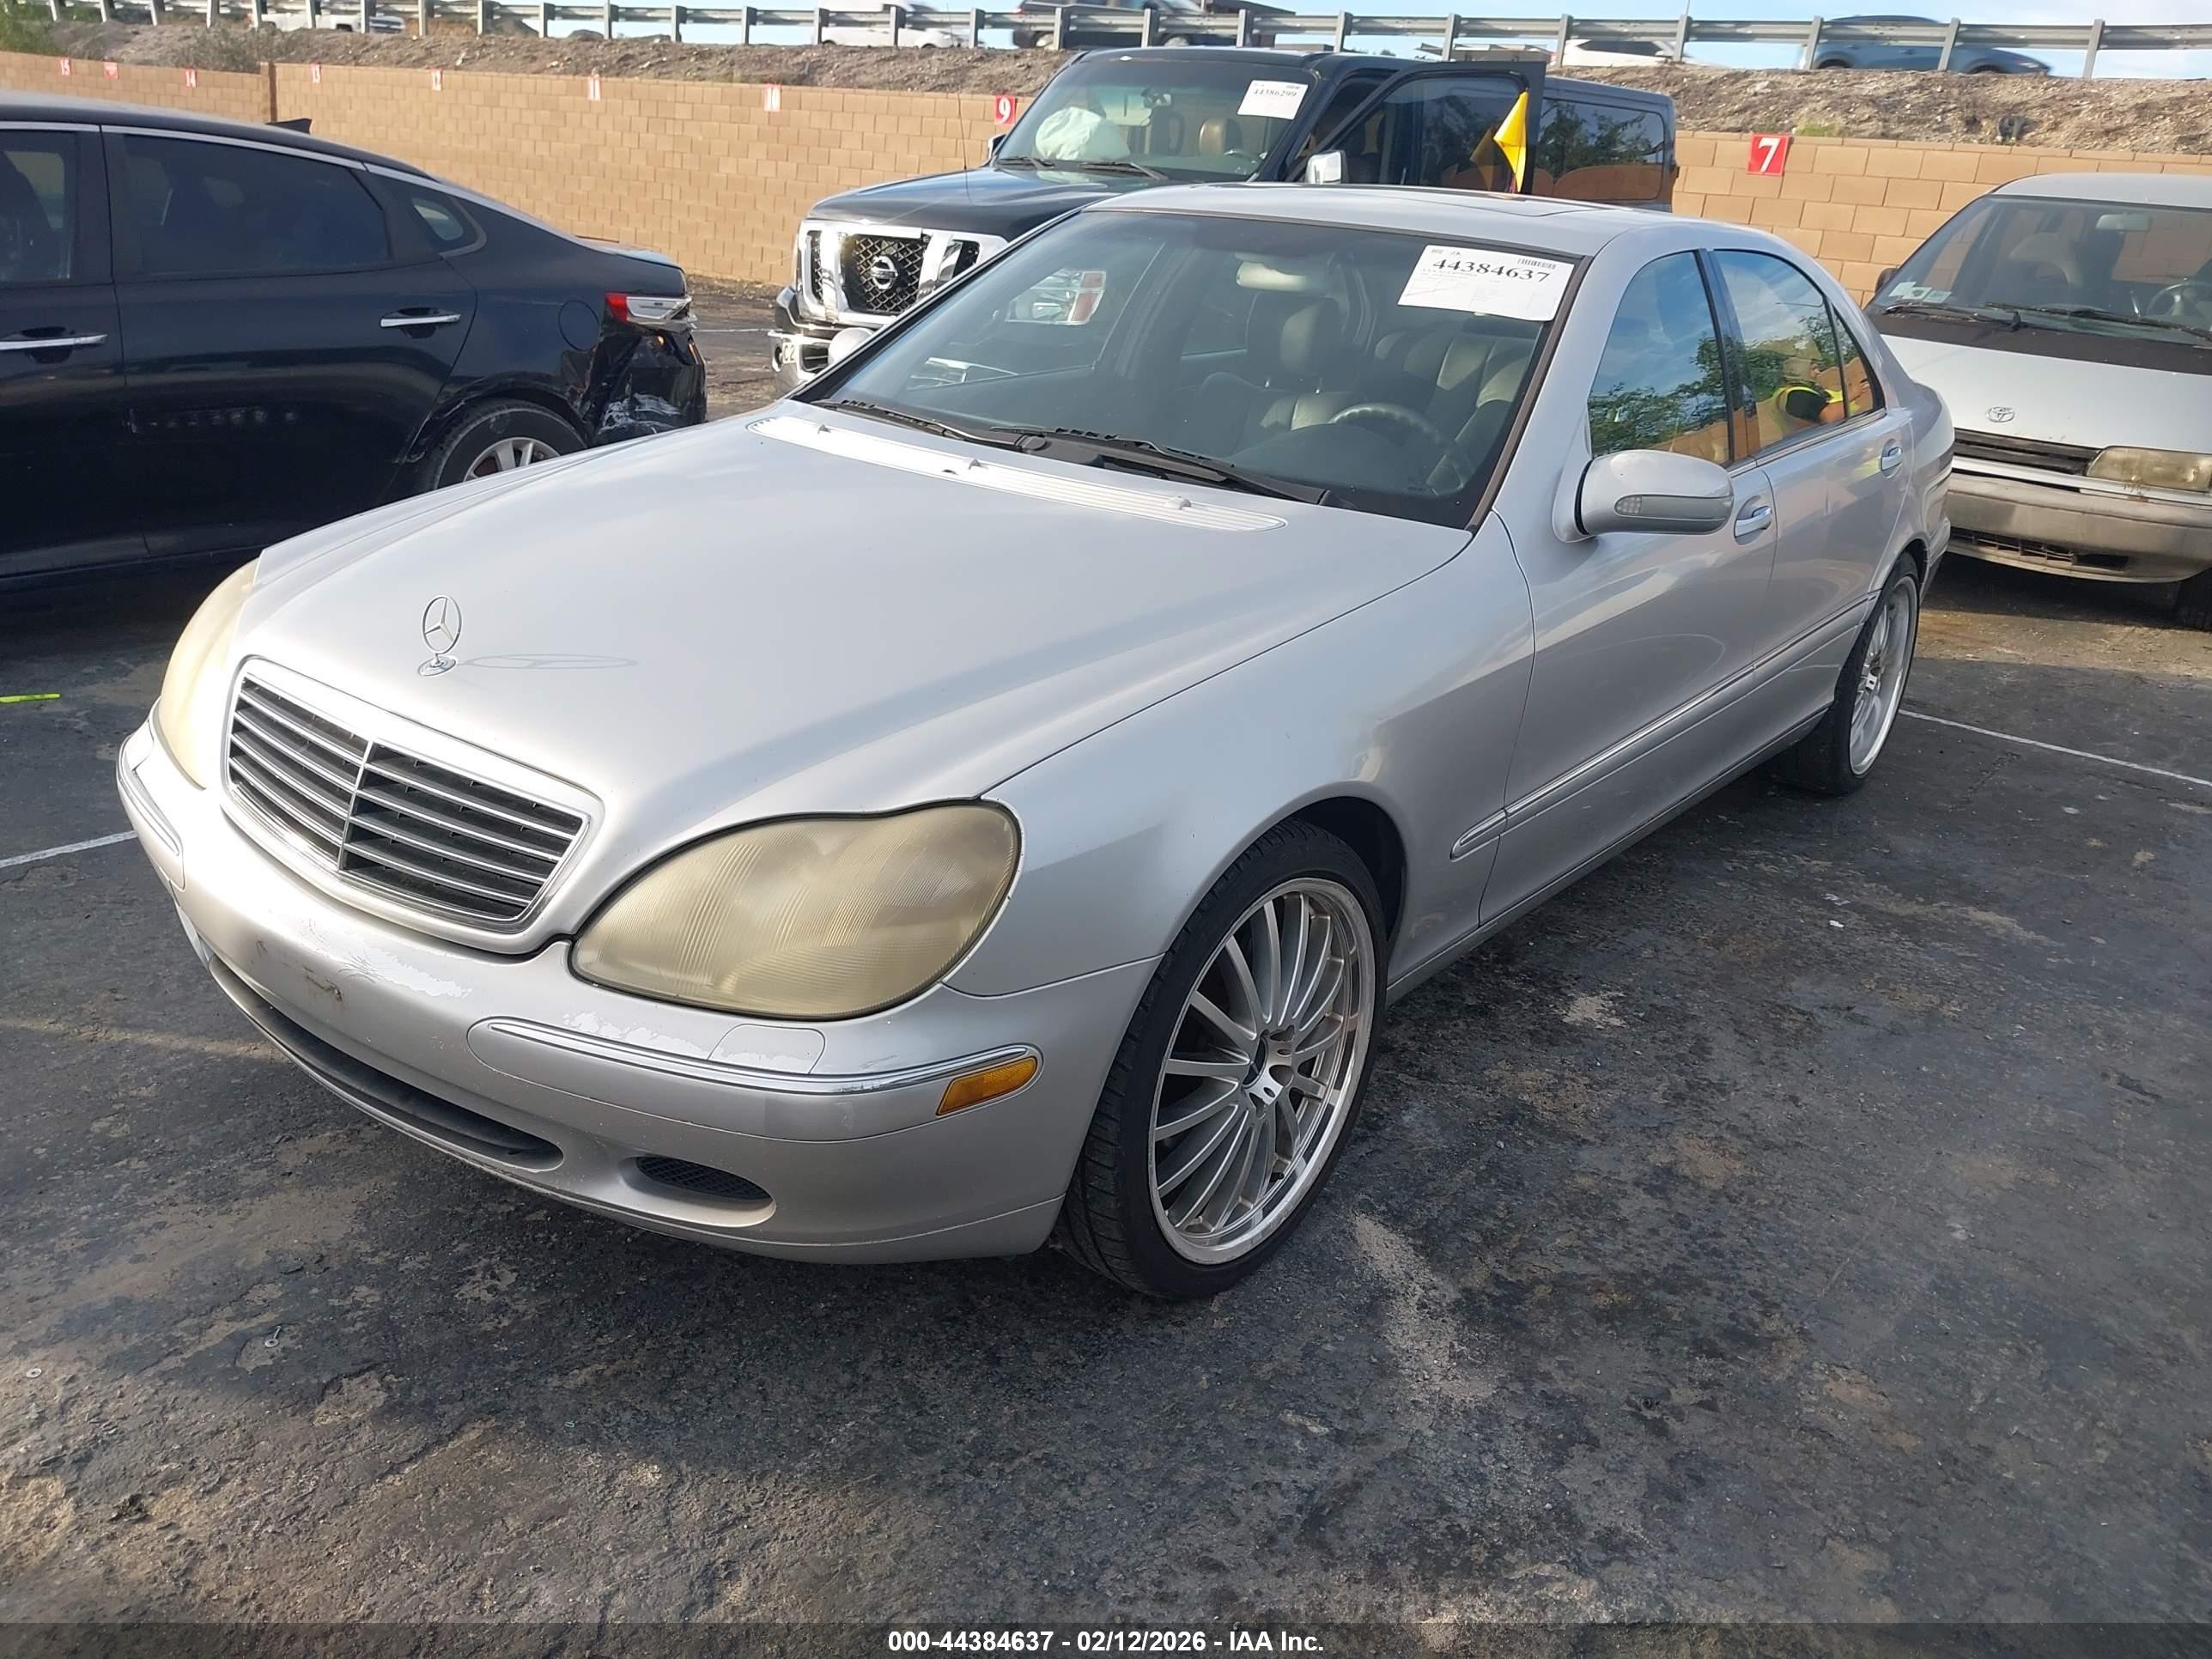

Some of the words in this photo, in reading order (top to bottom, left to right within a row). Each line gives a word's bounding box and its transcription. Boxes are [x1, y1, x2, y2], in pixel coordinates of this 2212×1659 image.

[185, 69, 196, 88] 14
[998, 96, 1011, 124] 9
[1758, 137, 1781, 173] 7
[1432, 258, 1551, 283] 44384637
